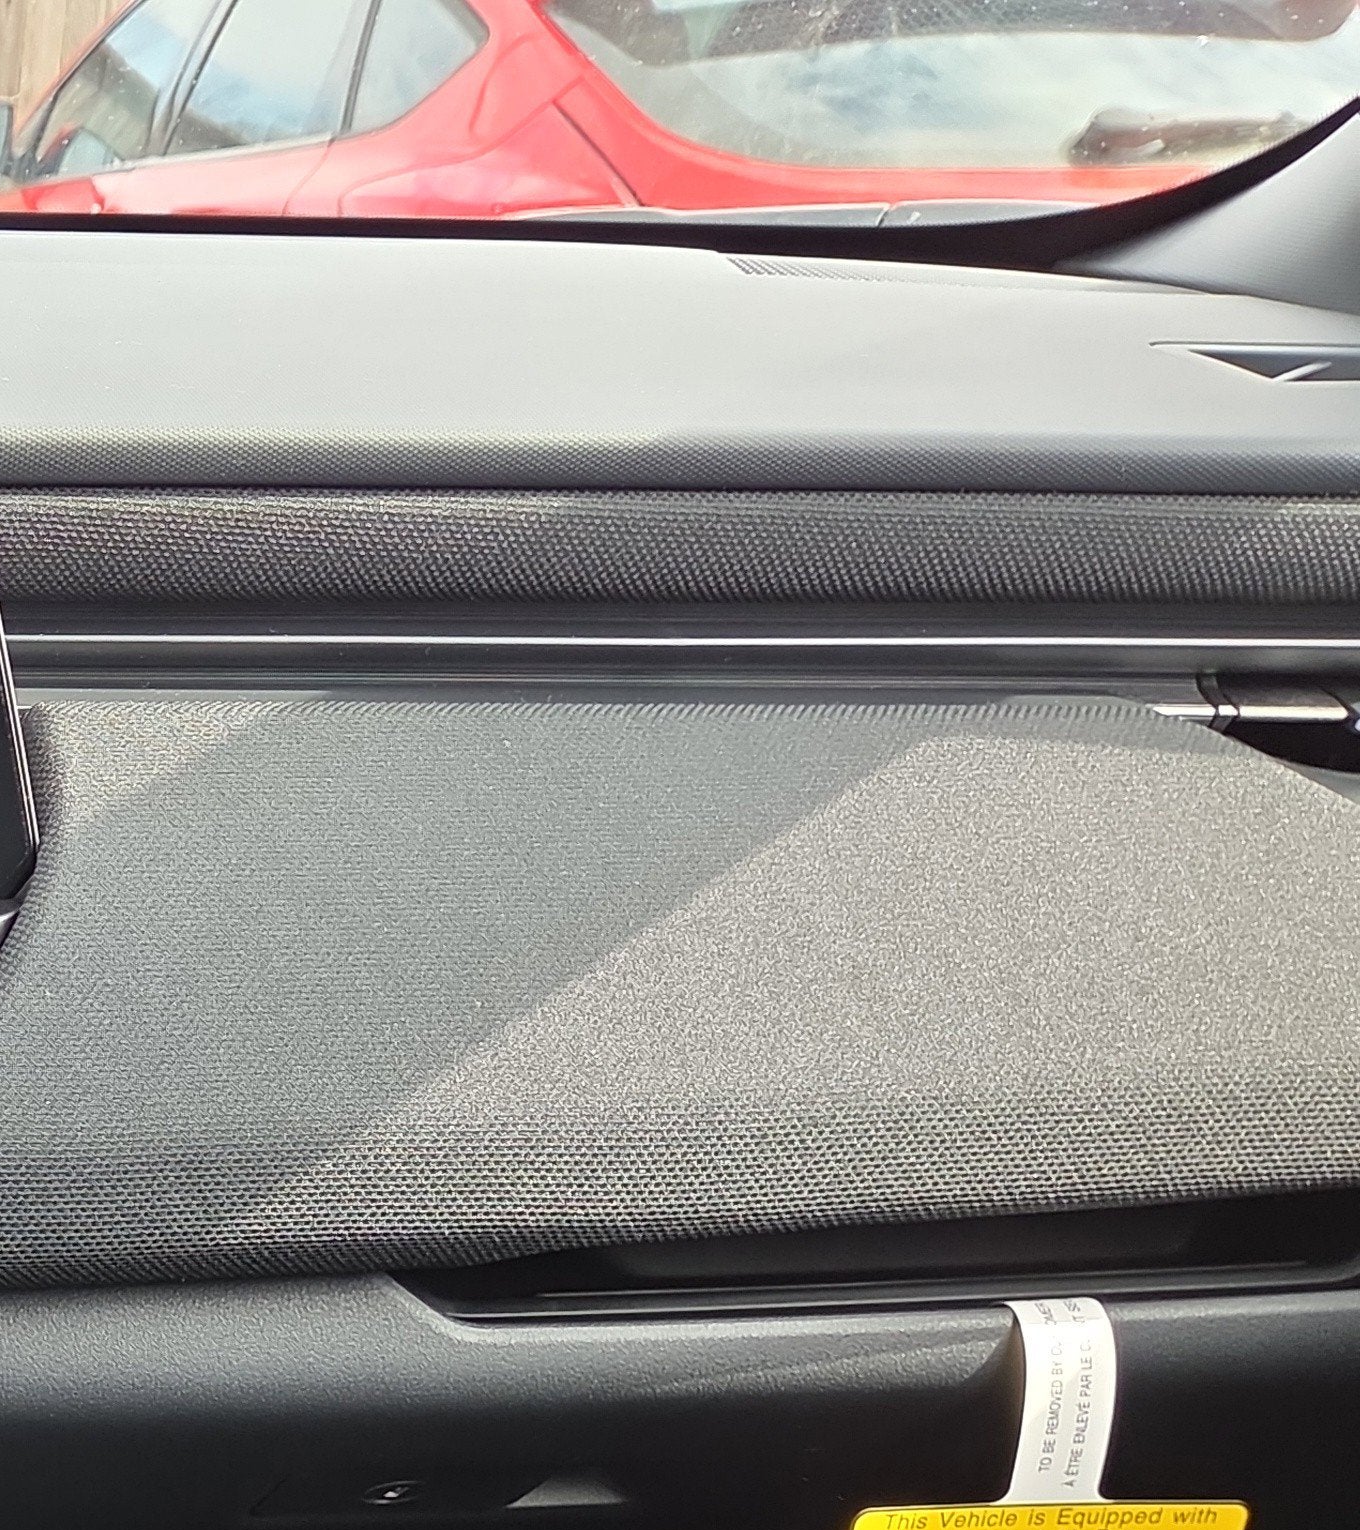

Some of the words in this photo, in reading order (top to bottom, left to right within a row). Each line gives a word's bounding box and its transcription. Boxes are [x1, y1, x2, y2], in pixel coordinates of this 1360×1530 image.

[1080, 1356, 1093, 1370] LE
[1080, 1374, 1093, 1398] PAR
[1046, 1380, 1062, 1435] REMOVED
[1042, 1438, 1056, 1454] BE
[1038, 1456, 1052, 1472] TO
[885, 1514, 928, 1530] This
[940, 1510, 1018, 1528] Vehicle
[1028, 1508, 1046, 1526] is
[1057, 1508, 1164, 1528] Equipped
[1172, 1506, 1218, 1524] with
